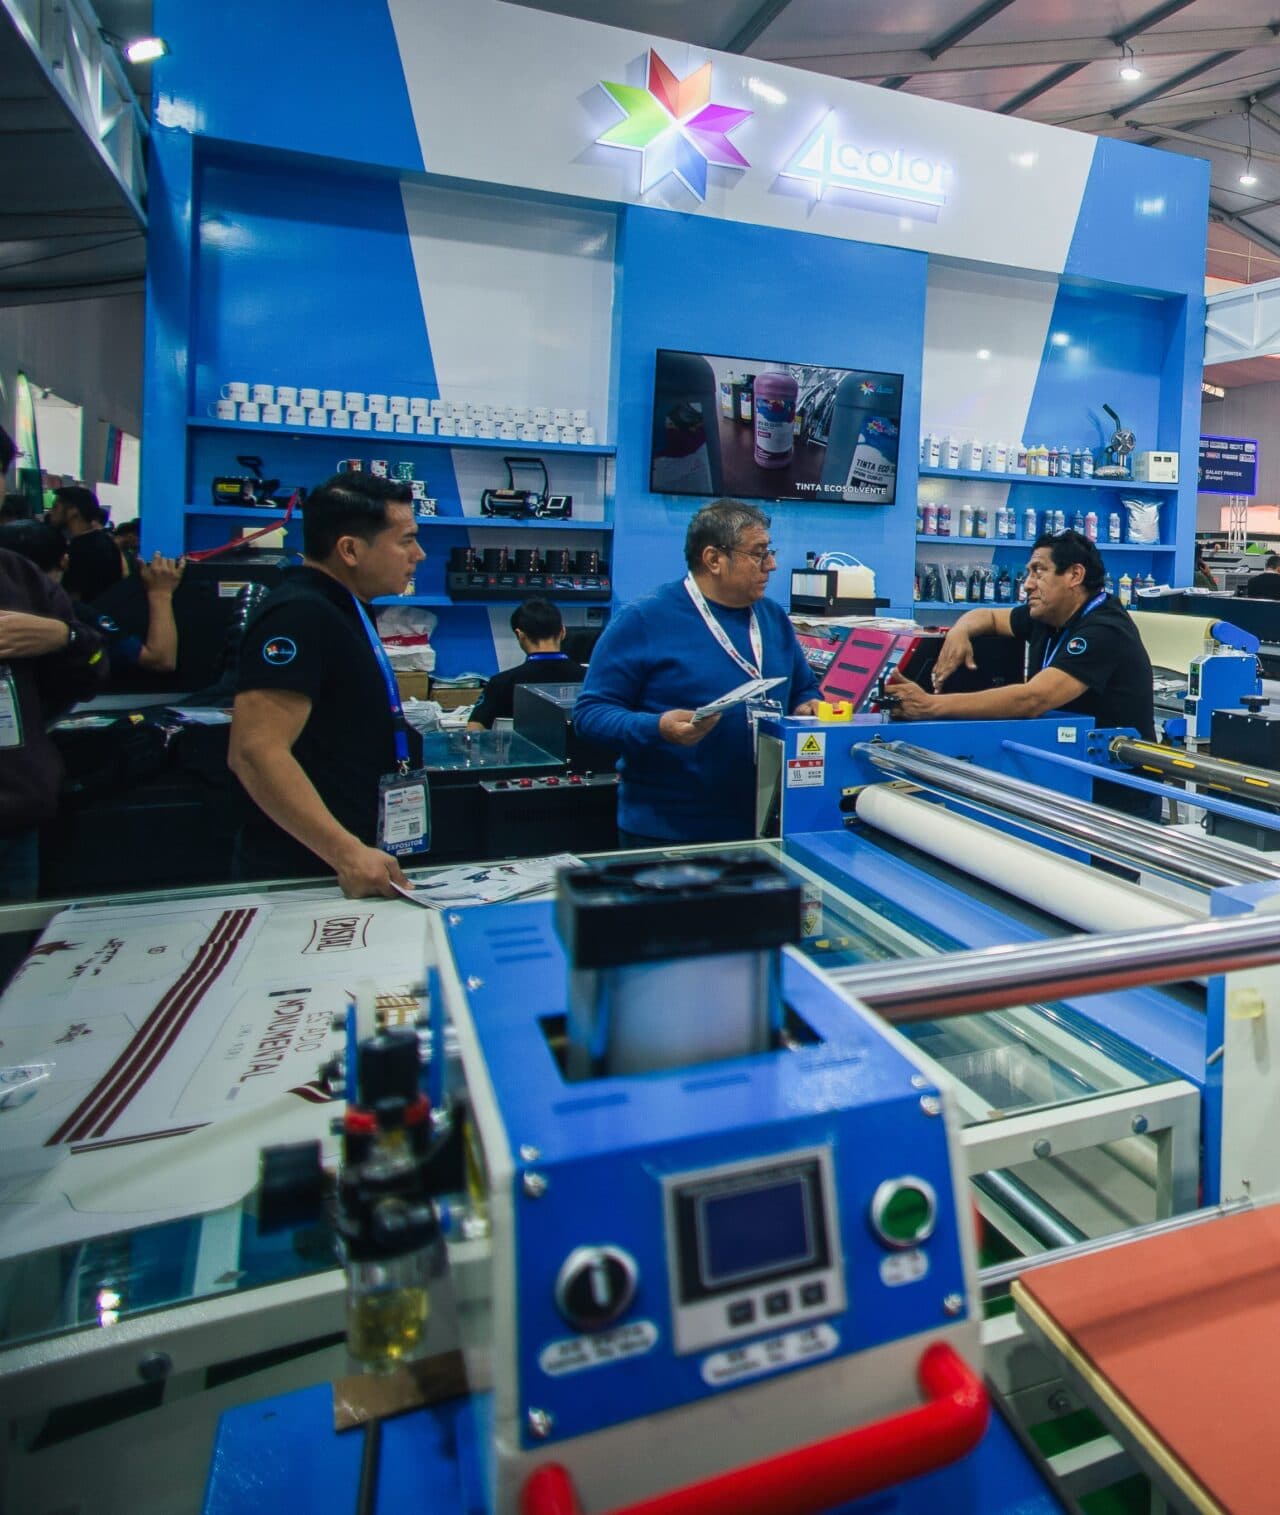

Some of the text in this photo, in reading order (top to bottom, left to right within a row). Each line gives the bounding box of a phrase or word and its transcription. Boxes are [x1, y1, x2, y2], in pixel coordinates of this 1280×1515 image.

[779, 105, 952, 206] 4color
[794, 482, 887, 495] TINTA ECOSOLVENTE
[386, 839, 423, 851] EXPOSITOR
